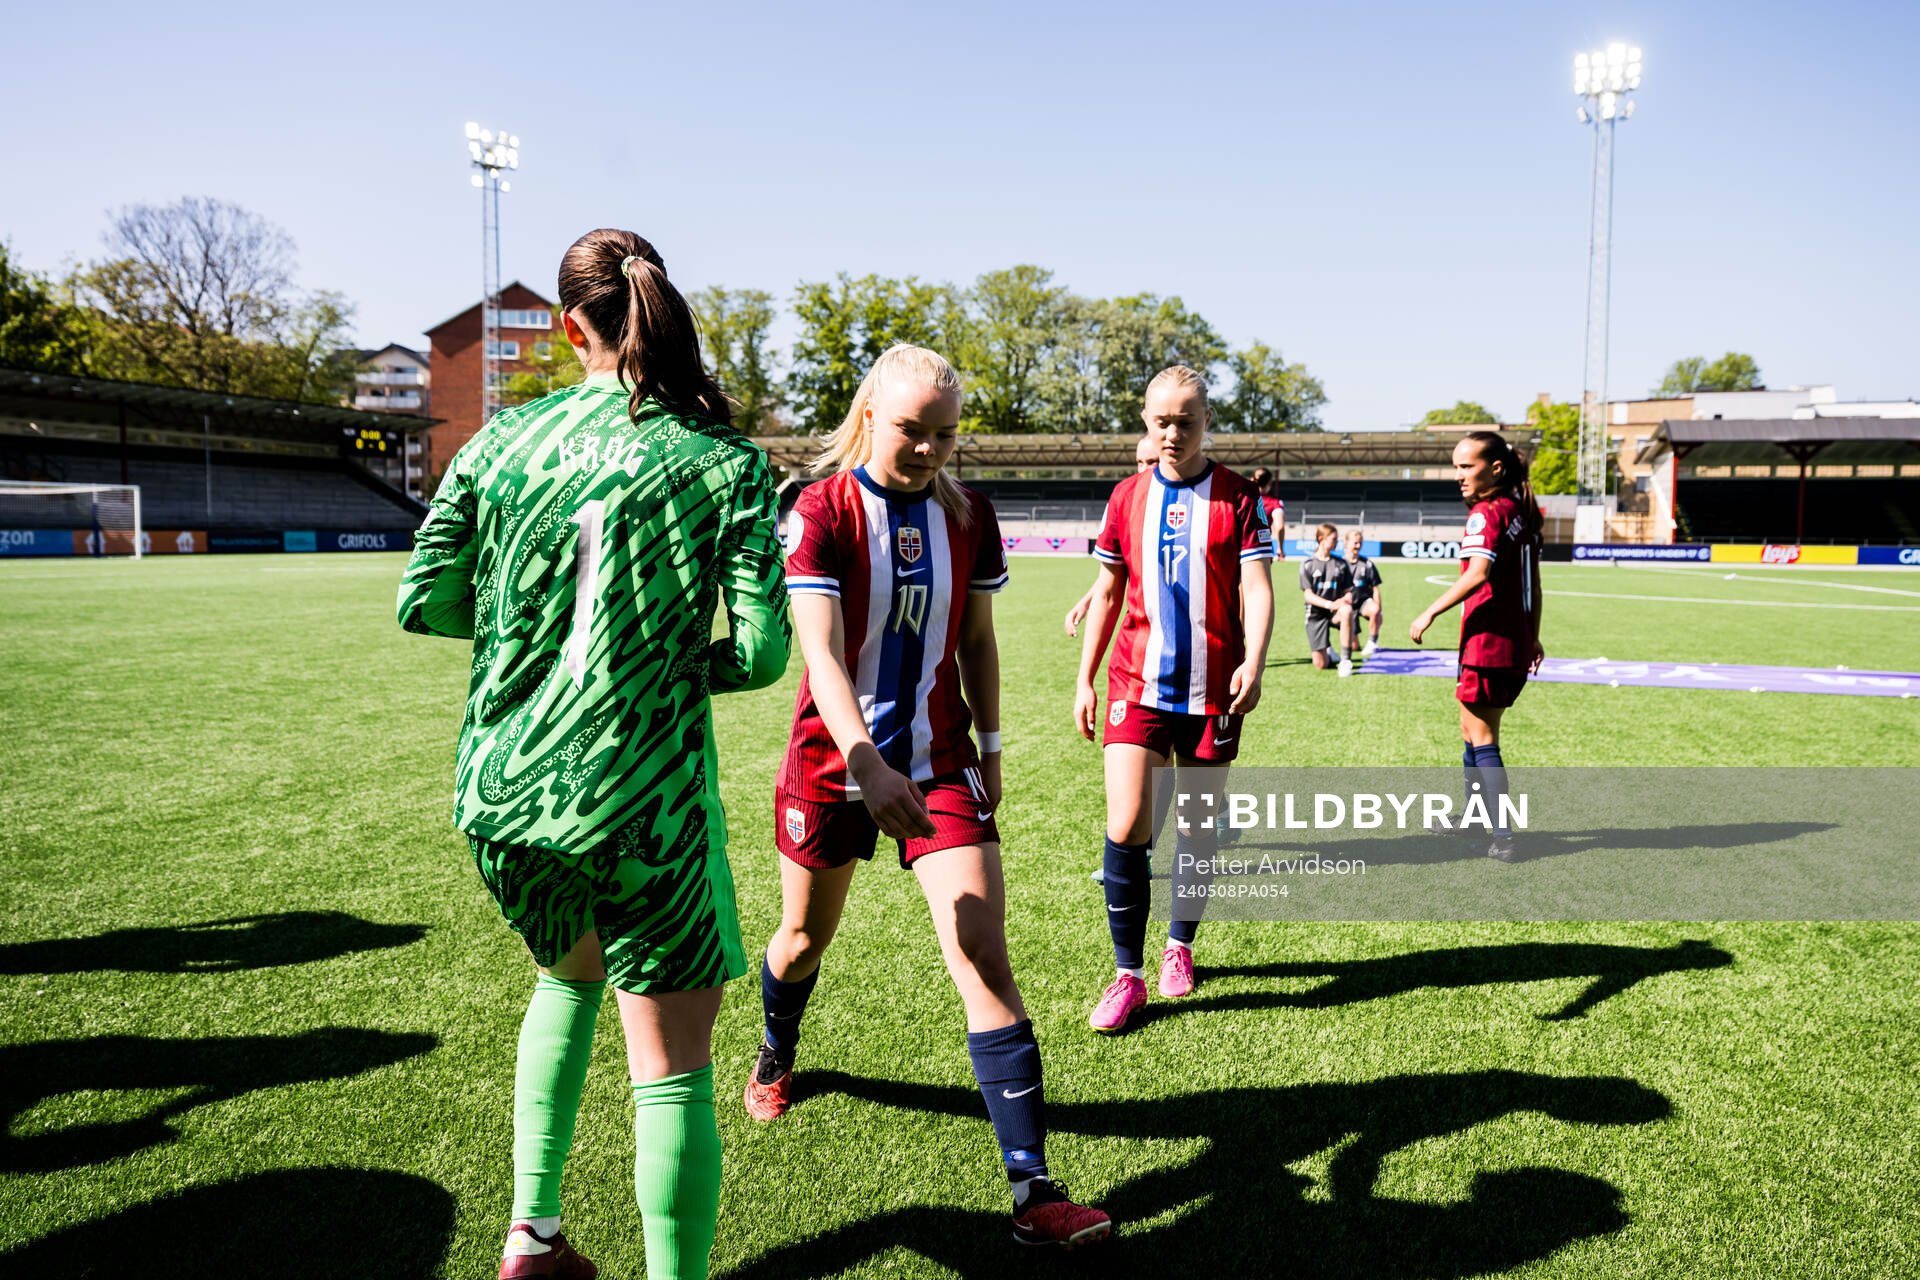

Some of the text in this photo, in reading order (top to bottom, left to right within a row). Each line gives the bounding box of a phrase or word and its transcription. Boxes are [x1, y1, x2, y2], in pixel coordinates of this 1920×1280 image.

[338, 533, 387, 549] GRIFOLS
[1161, 544, 1188, 585] 17
[565, 499, 605, 691] 1
[892, 584, 928, 636] 10
